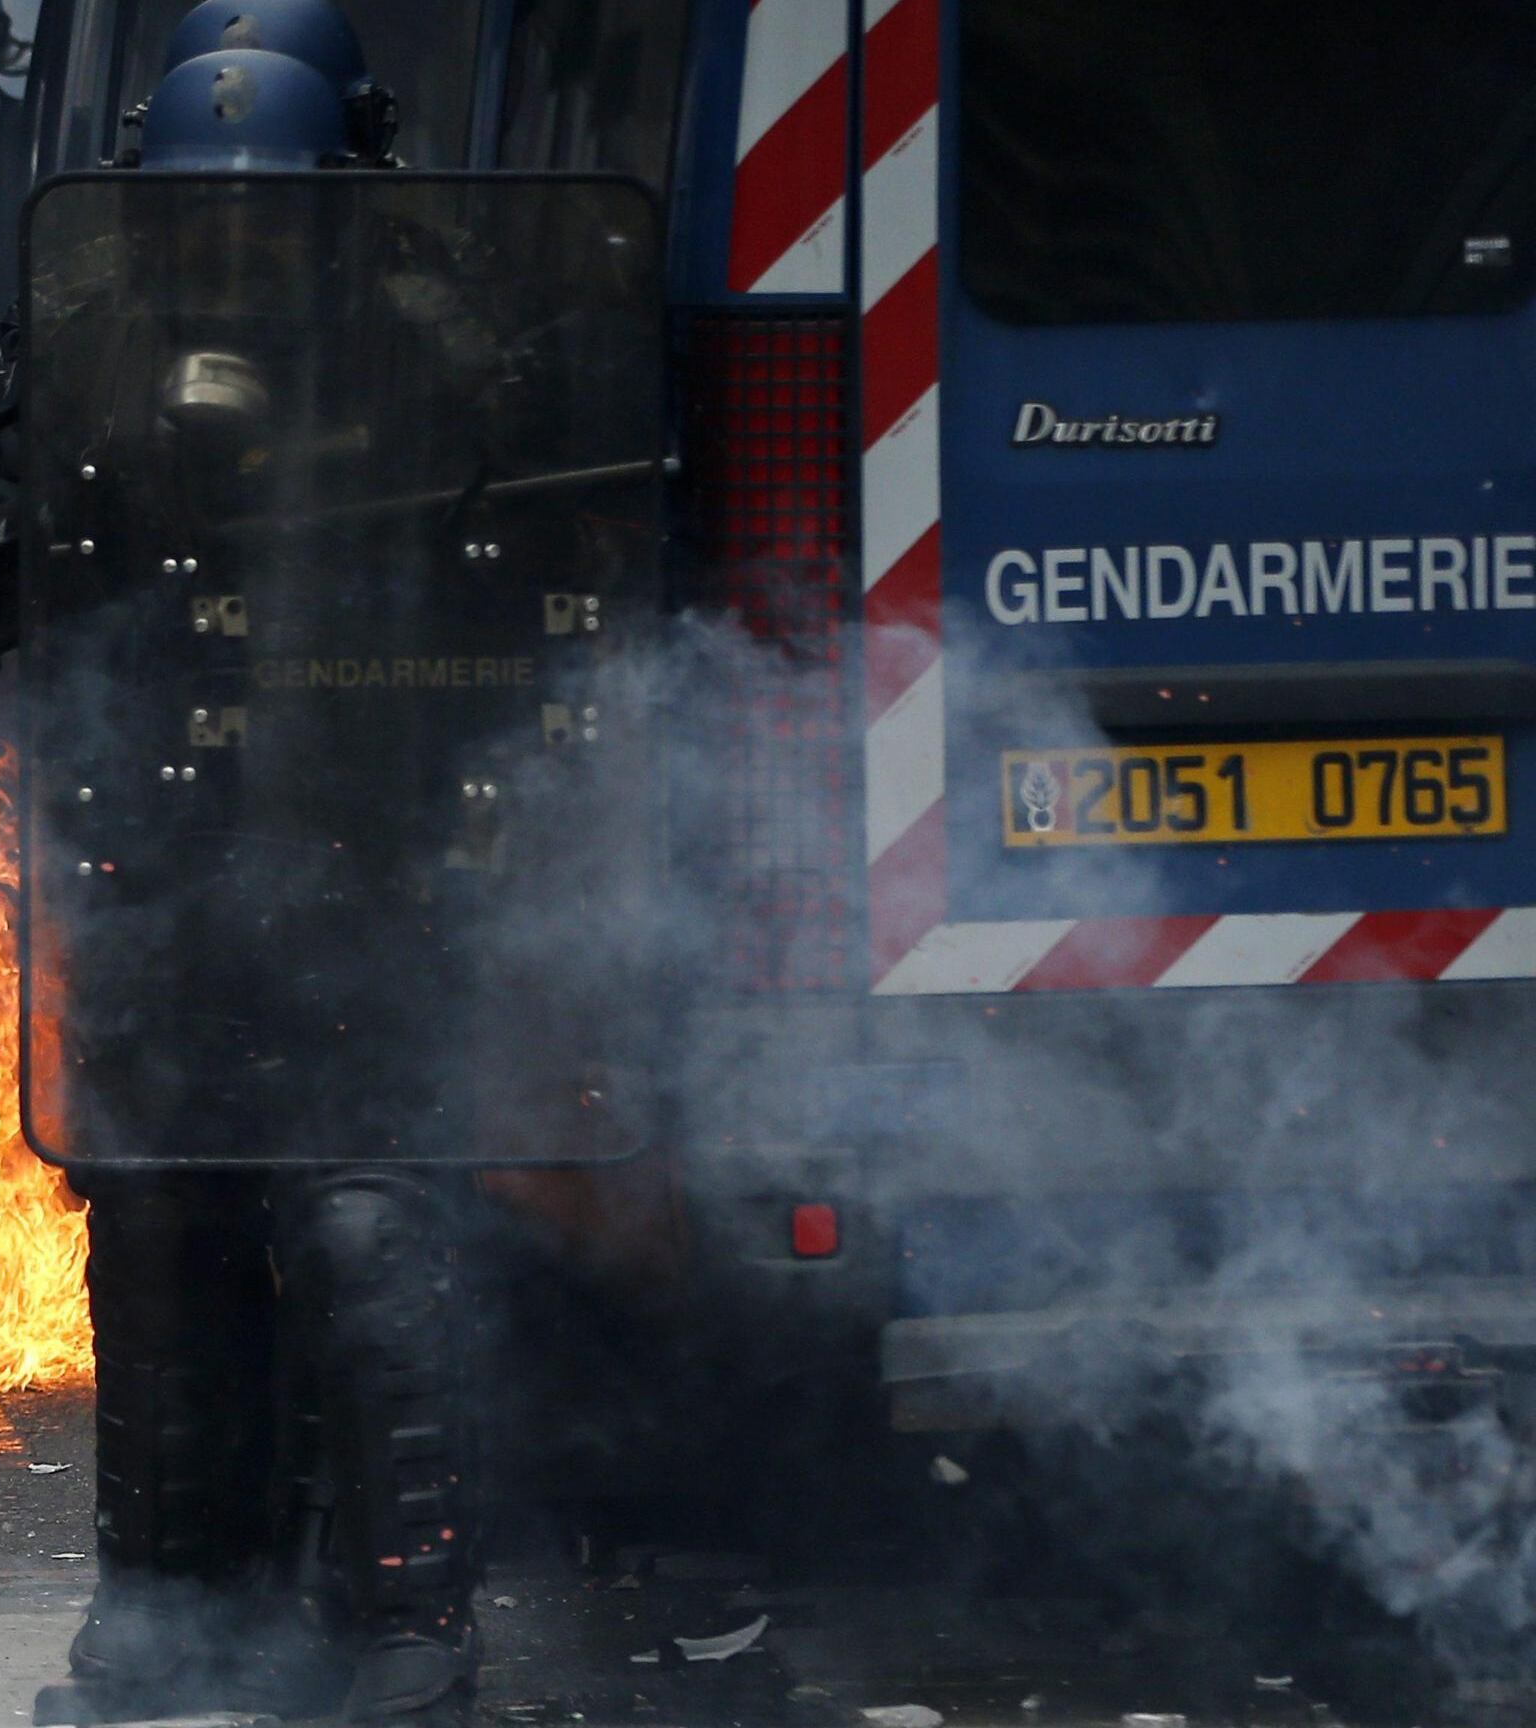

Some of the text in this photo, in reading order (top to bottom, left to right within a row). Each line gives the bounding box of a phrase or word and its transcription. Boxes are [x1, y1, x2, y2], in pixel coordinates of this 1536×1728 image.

[1012, 402, 1217, 444] Durisotti
[985, 536, 1536, 625] GENDARMERIE
[254, 657, 535, 688] GENDARMERIE
[1072, 746, 1493, 835] 2051 0765
